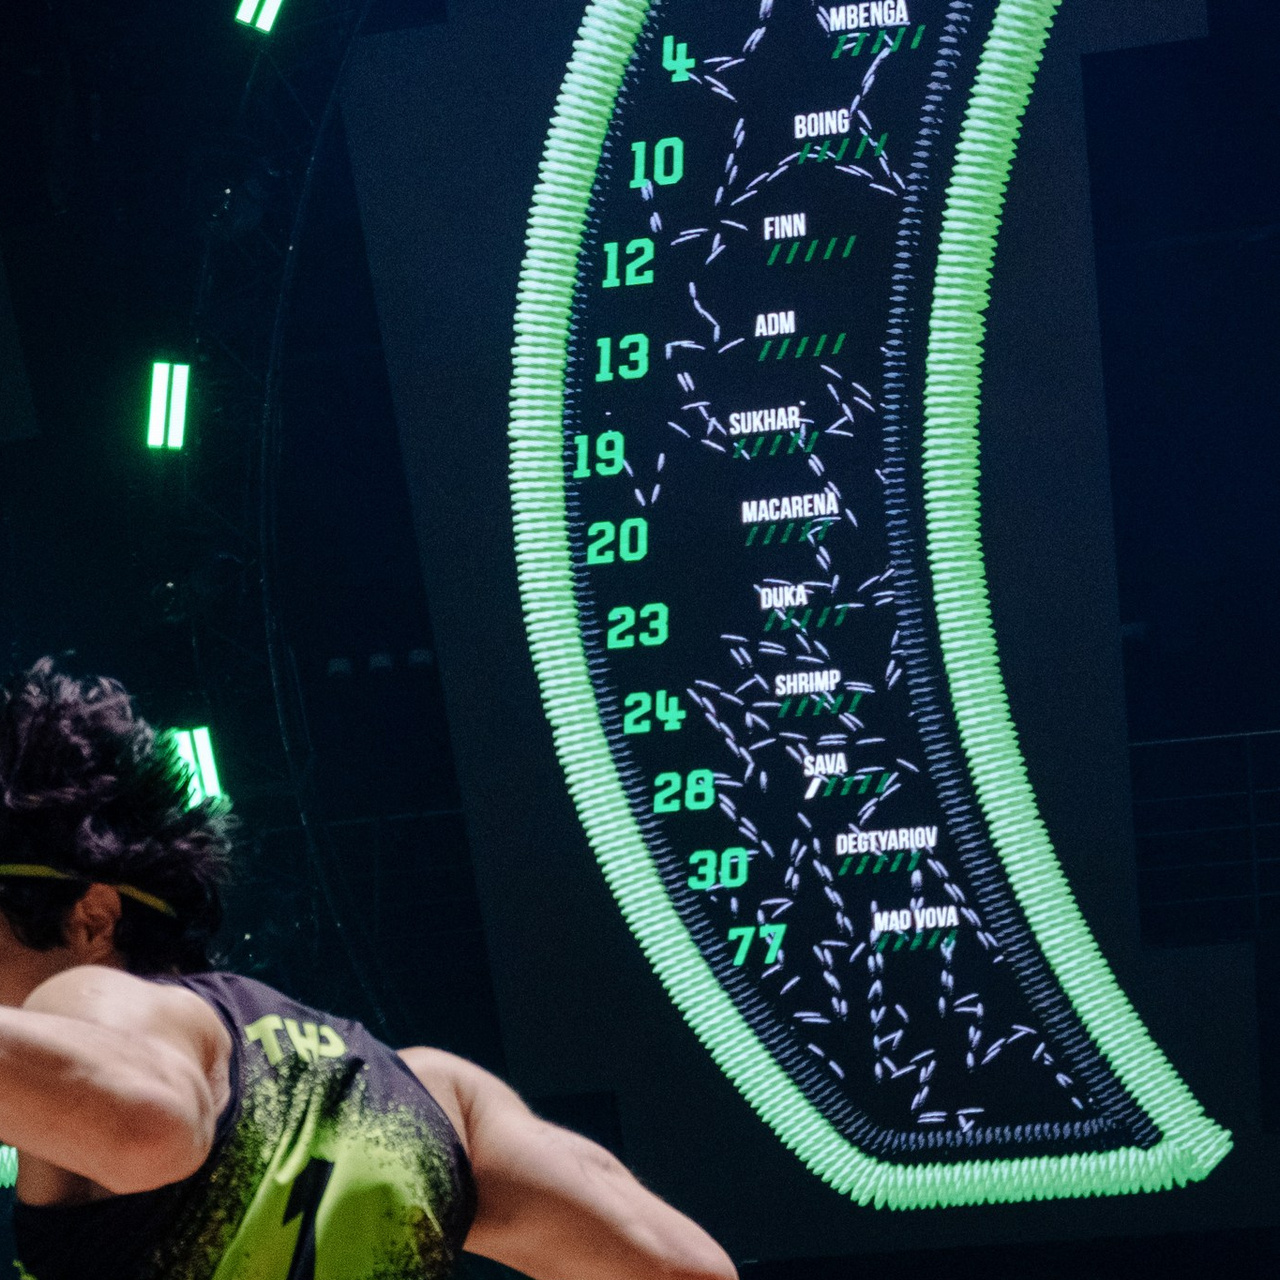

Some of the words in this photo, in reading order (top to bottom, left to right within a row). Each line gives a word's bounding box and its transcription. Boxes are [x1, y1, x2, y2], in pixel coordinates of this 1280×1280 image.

[829, 0, 909, 31] MBENGA
[662, 35, 695, 82] 4
[794, 109, 850, 138] BOING
[630, 137, 684, 188] 10
[764, 213, 806, 240] FINN
[602, 238, 655, 289] 12
[755, 311, 796, 337] ADM
[595, 333, 648, 383] 13
[729, 406, 801, 435] SUKHAR
[572, 431, 625, 479] 19
[742, 493, 838, 523] MACARENA
[586, 518, 648, 565] 20
[760, 585, 808, 610] DUKA
[606, 602, 669, 649] 23
[775, 669, 841, 696] SHRIMP
[623, 690, 686, 735] 24
[803, 753, 848, 777] SAVA
[653, 769, 715, 813] 28
[836, 825, 938, 855] DEGTYARIOV
[687, 847, 749, 890] 30
[873, 907, 911, 933] MAD
[914, 905, 959, 930] VOVA
[727, 923, 787, 966] 77
